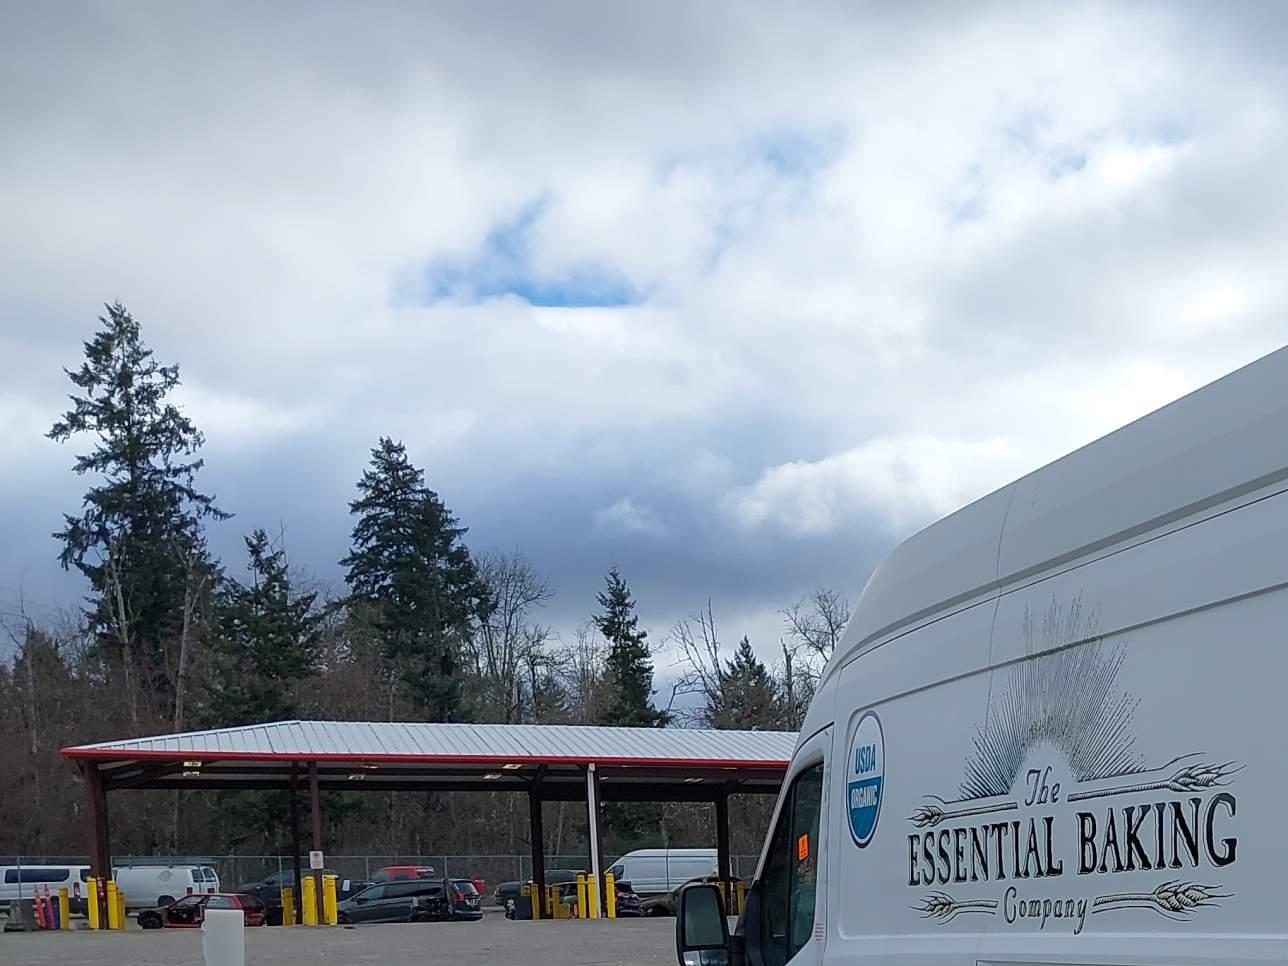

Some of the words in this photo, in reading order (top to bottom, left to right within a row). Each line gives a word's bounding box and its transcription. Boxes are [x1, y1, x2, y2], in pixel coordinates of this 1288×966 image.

[855, 743, 877, 775] USDA
[851, 784, 878, 810] ORGANIC
[1025, 766, 1060, 806] The
[907, 816, 1064, 886] ESSENTIAL
[1076, 792, 1238, 875] BAKING
[1003, 886, 1089, 935] Company
